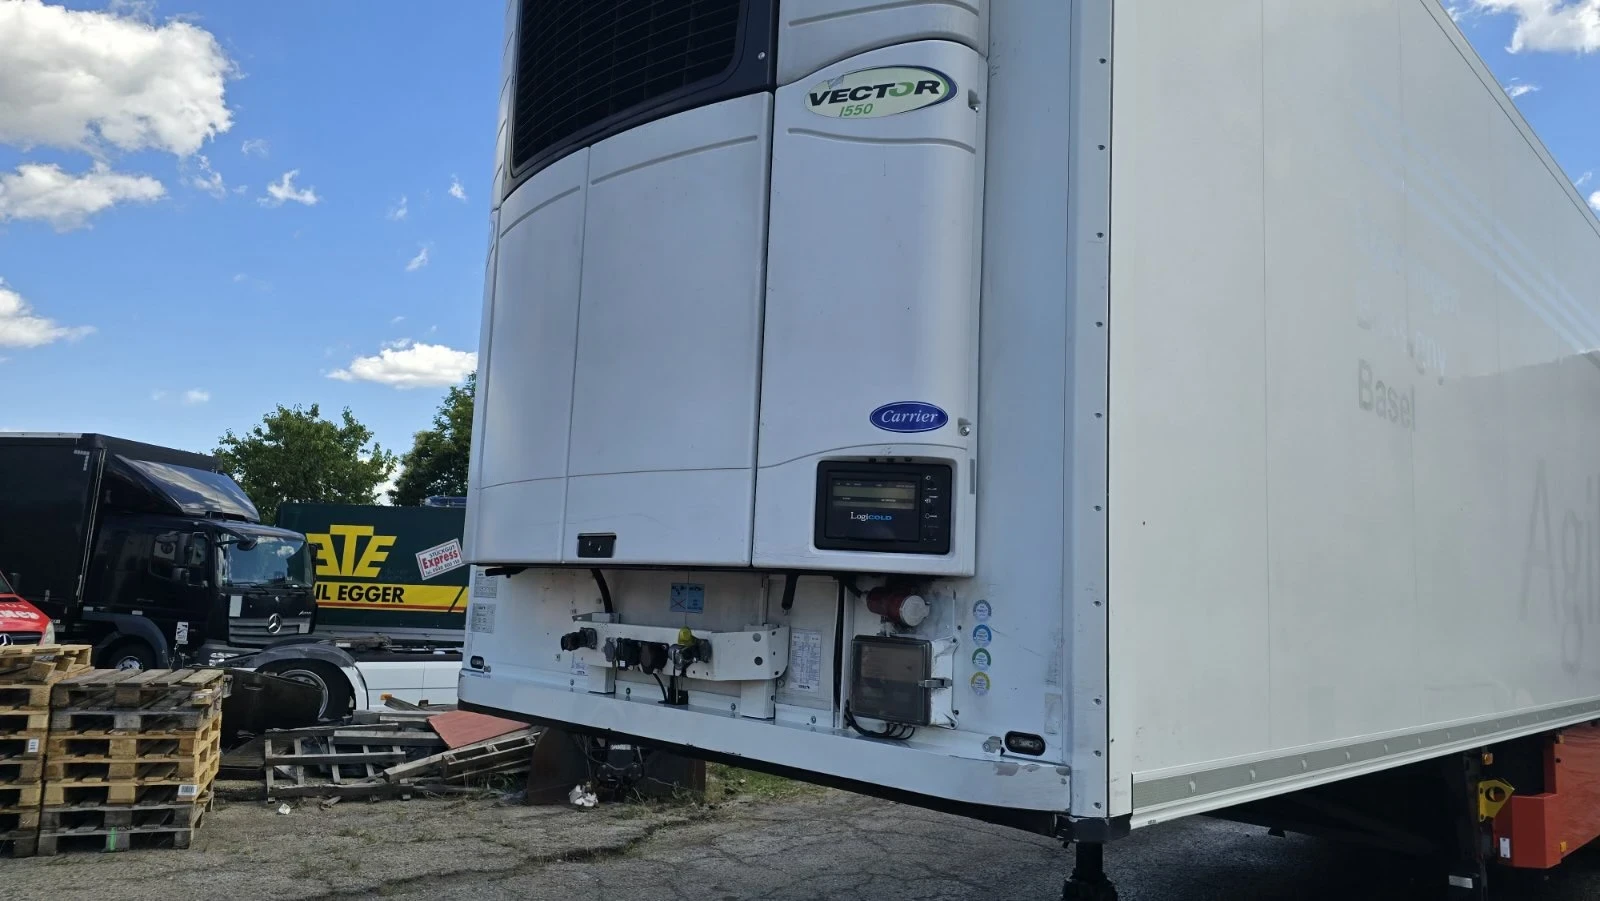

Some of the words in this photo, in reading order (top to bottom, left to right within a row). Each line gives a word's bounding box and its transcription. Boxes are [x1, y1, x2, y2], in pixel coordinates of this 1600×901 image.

[809, 80, 941, 107] VECTOR
[838, 103, 873, 118] 1550
[1357, 358, 1416, 432] Basel
[881, 410, 938, 423] Carrier
[422, 550, 458, 570] Express
[315, 584, 331, 601] IL
[337, 585, 405, 603] EGGER
